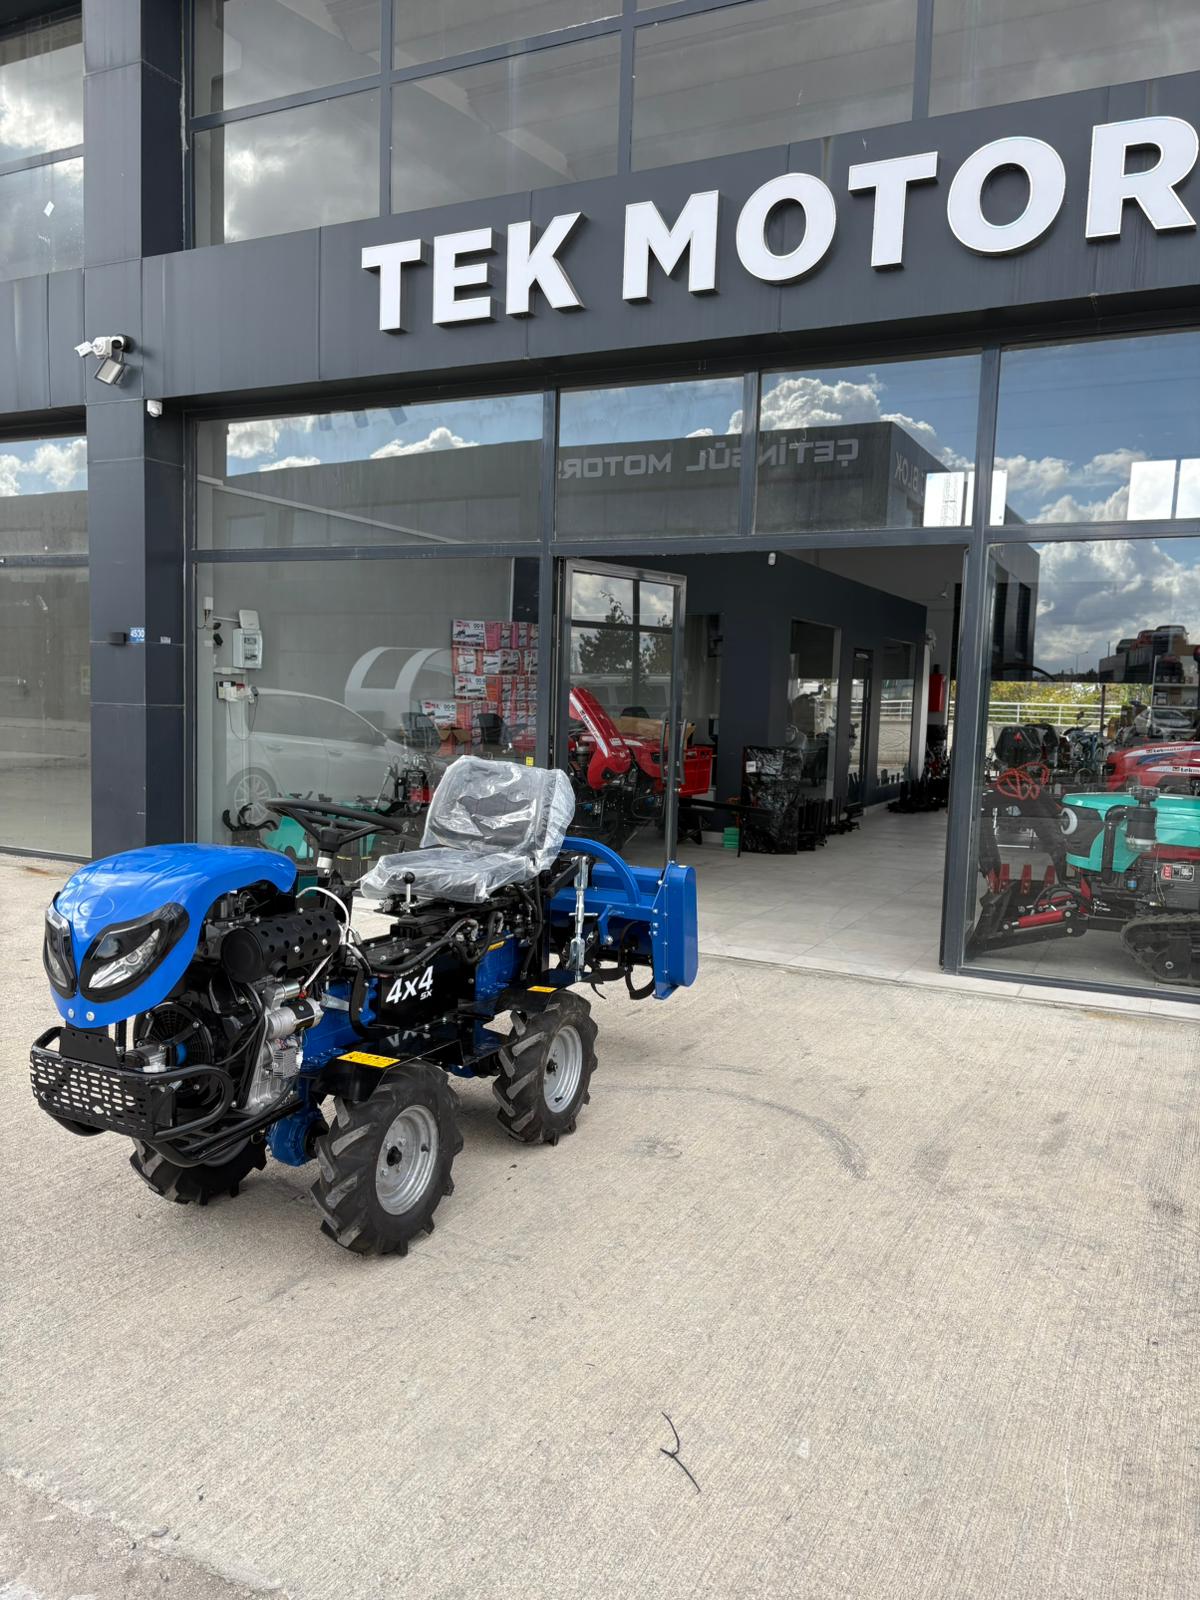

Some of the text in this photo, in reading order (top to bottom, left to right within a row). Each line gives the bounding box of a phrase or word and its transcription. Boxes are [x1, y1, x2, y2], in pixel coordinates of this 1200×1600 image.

[362, 116, 1199, 331] TEK MOTOR
[386, 966, 434, 1004] 4x4
